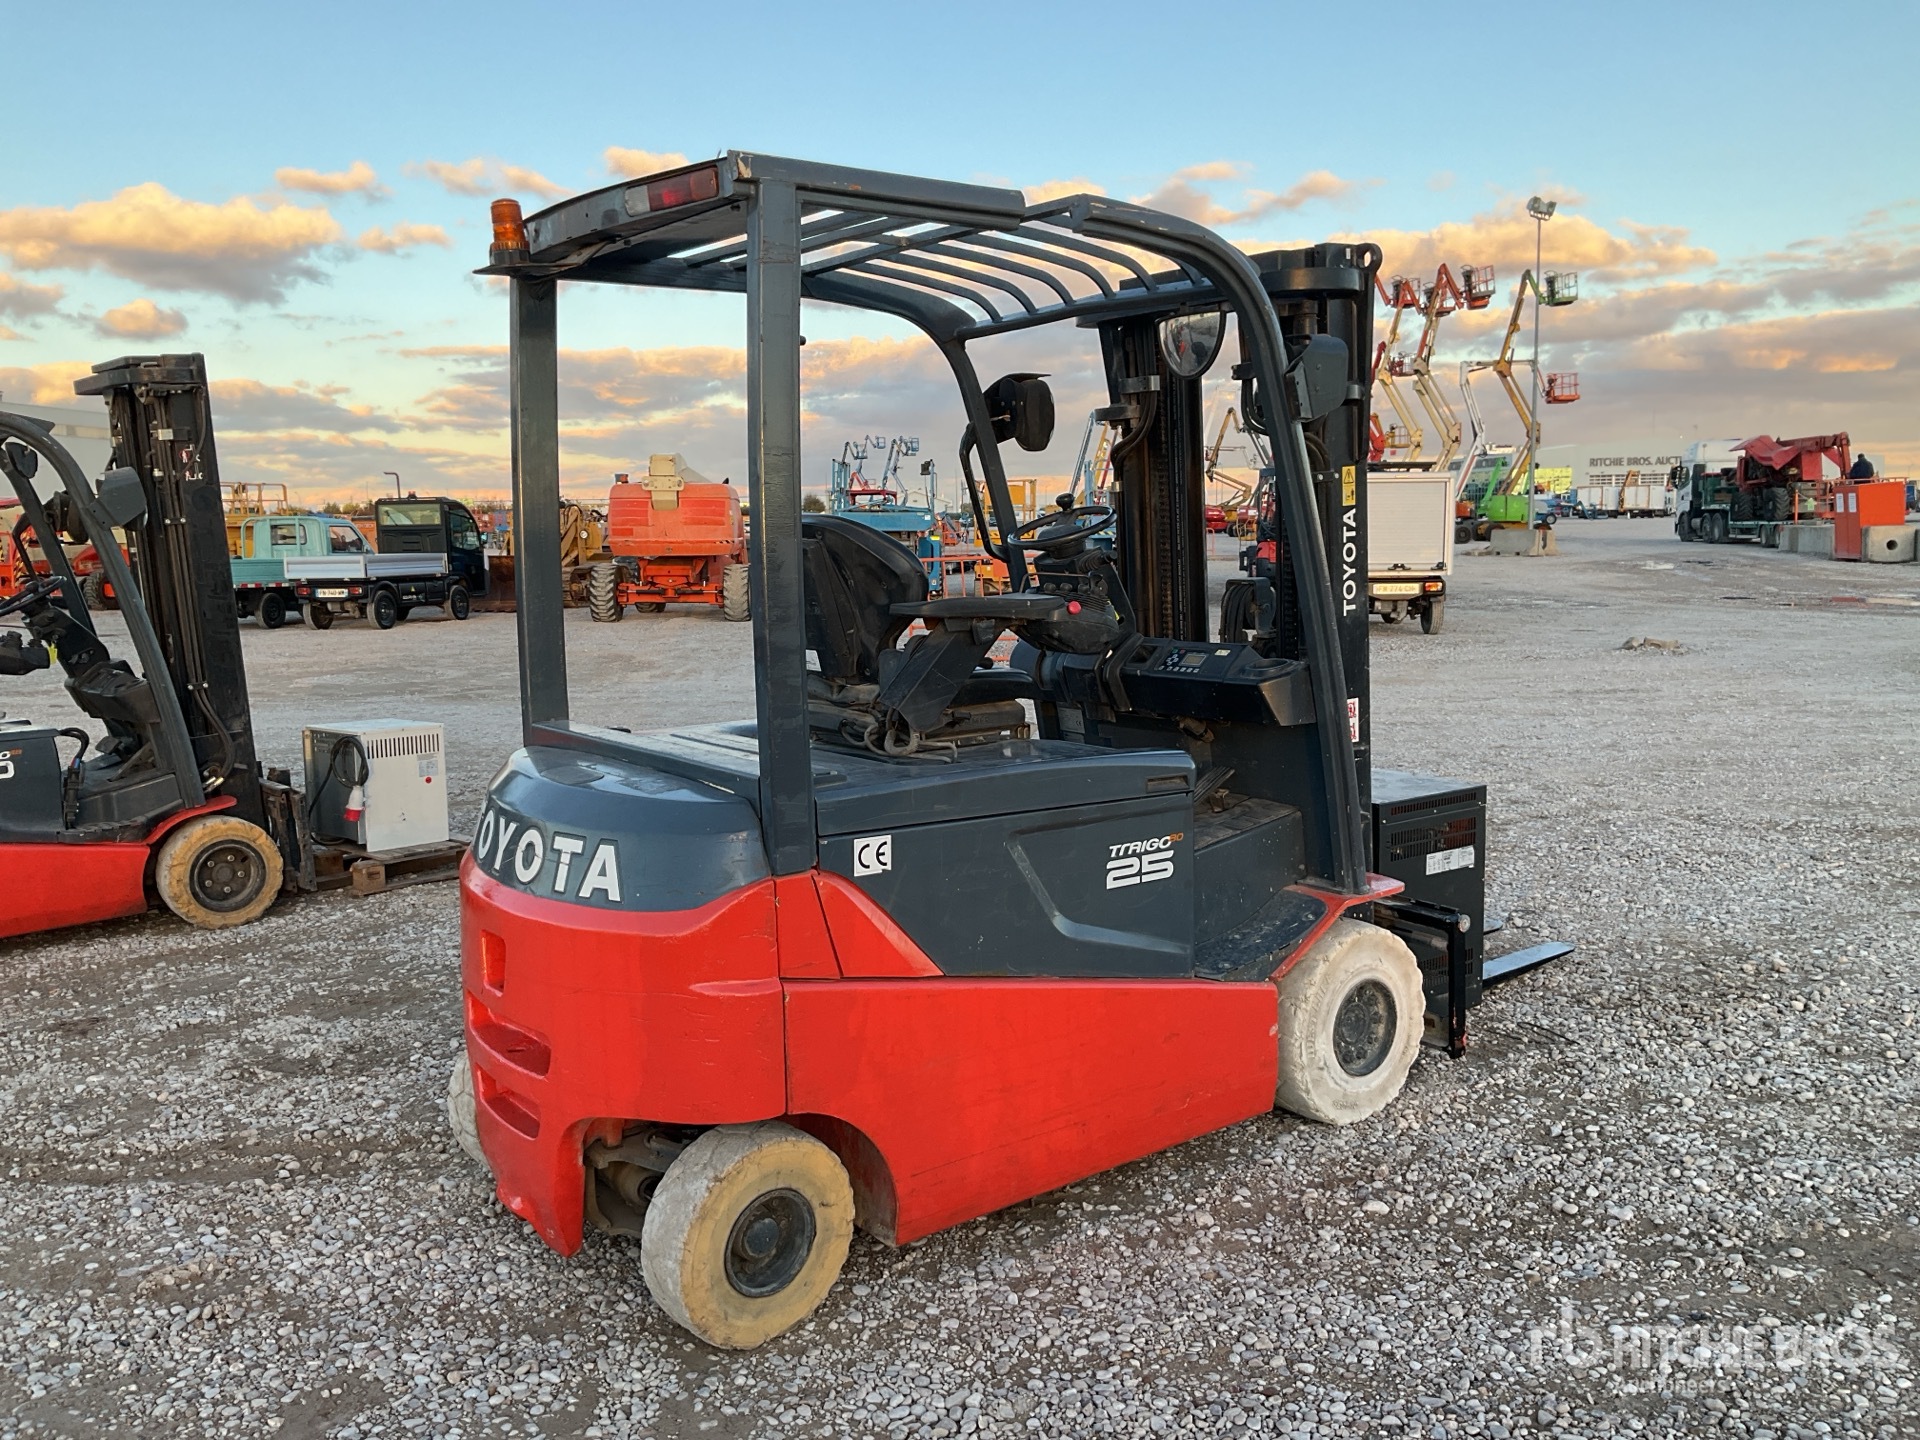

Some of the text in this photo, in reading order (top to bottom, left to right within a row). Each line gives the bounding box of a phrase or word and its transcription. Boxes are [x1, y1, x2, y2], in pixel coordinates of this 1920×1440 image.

[1590, 457, 1624, 467] RITCHIE
[1343, 508, 1356, 617] TOYOTA
[478, 809, 621, 902] OYOTA
[858, 841, 888, 869] CE
[1106, 850, 1174, 890] 25
